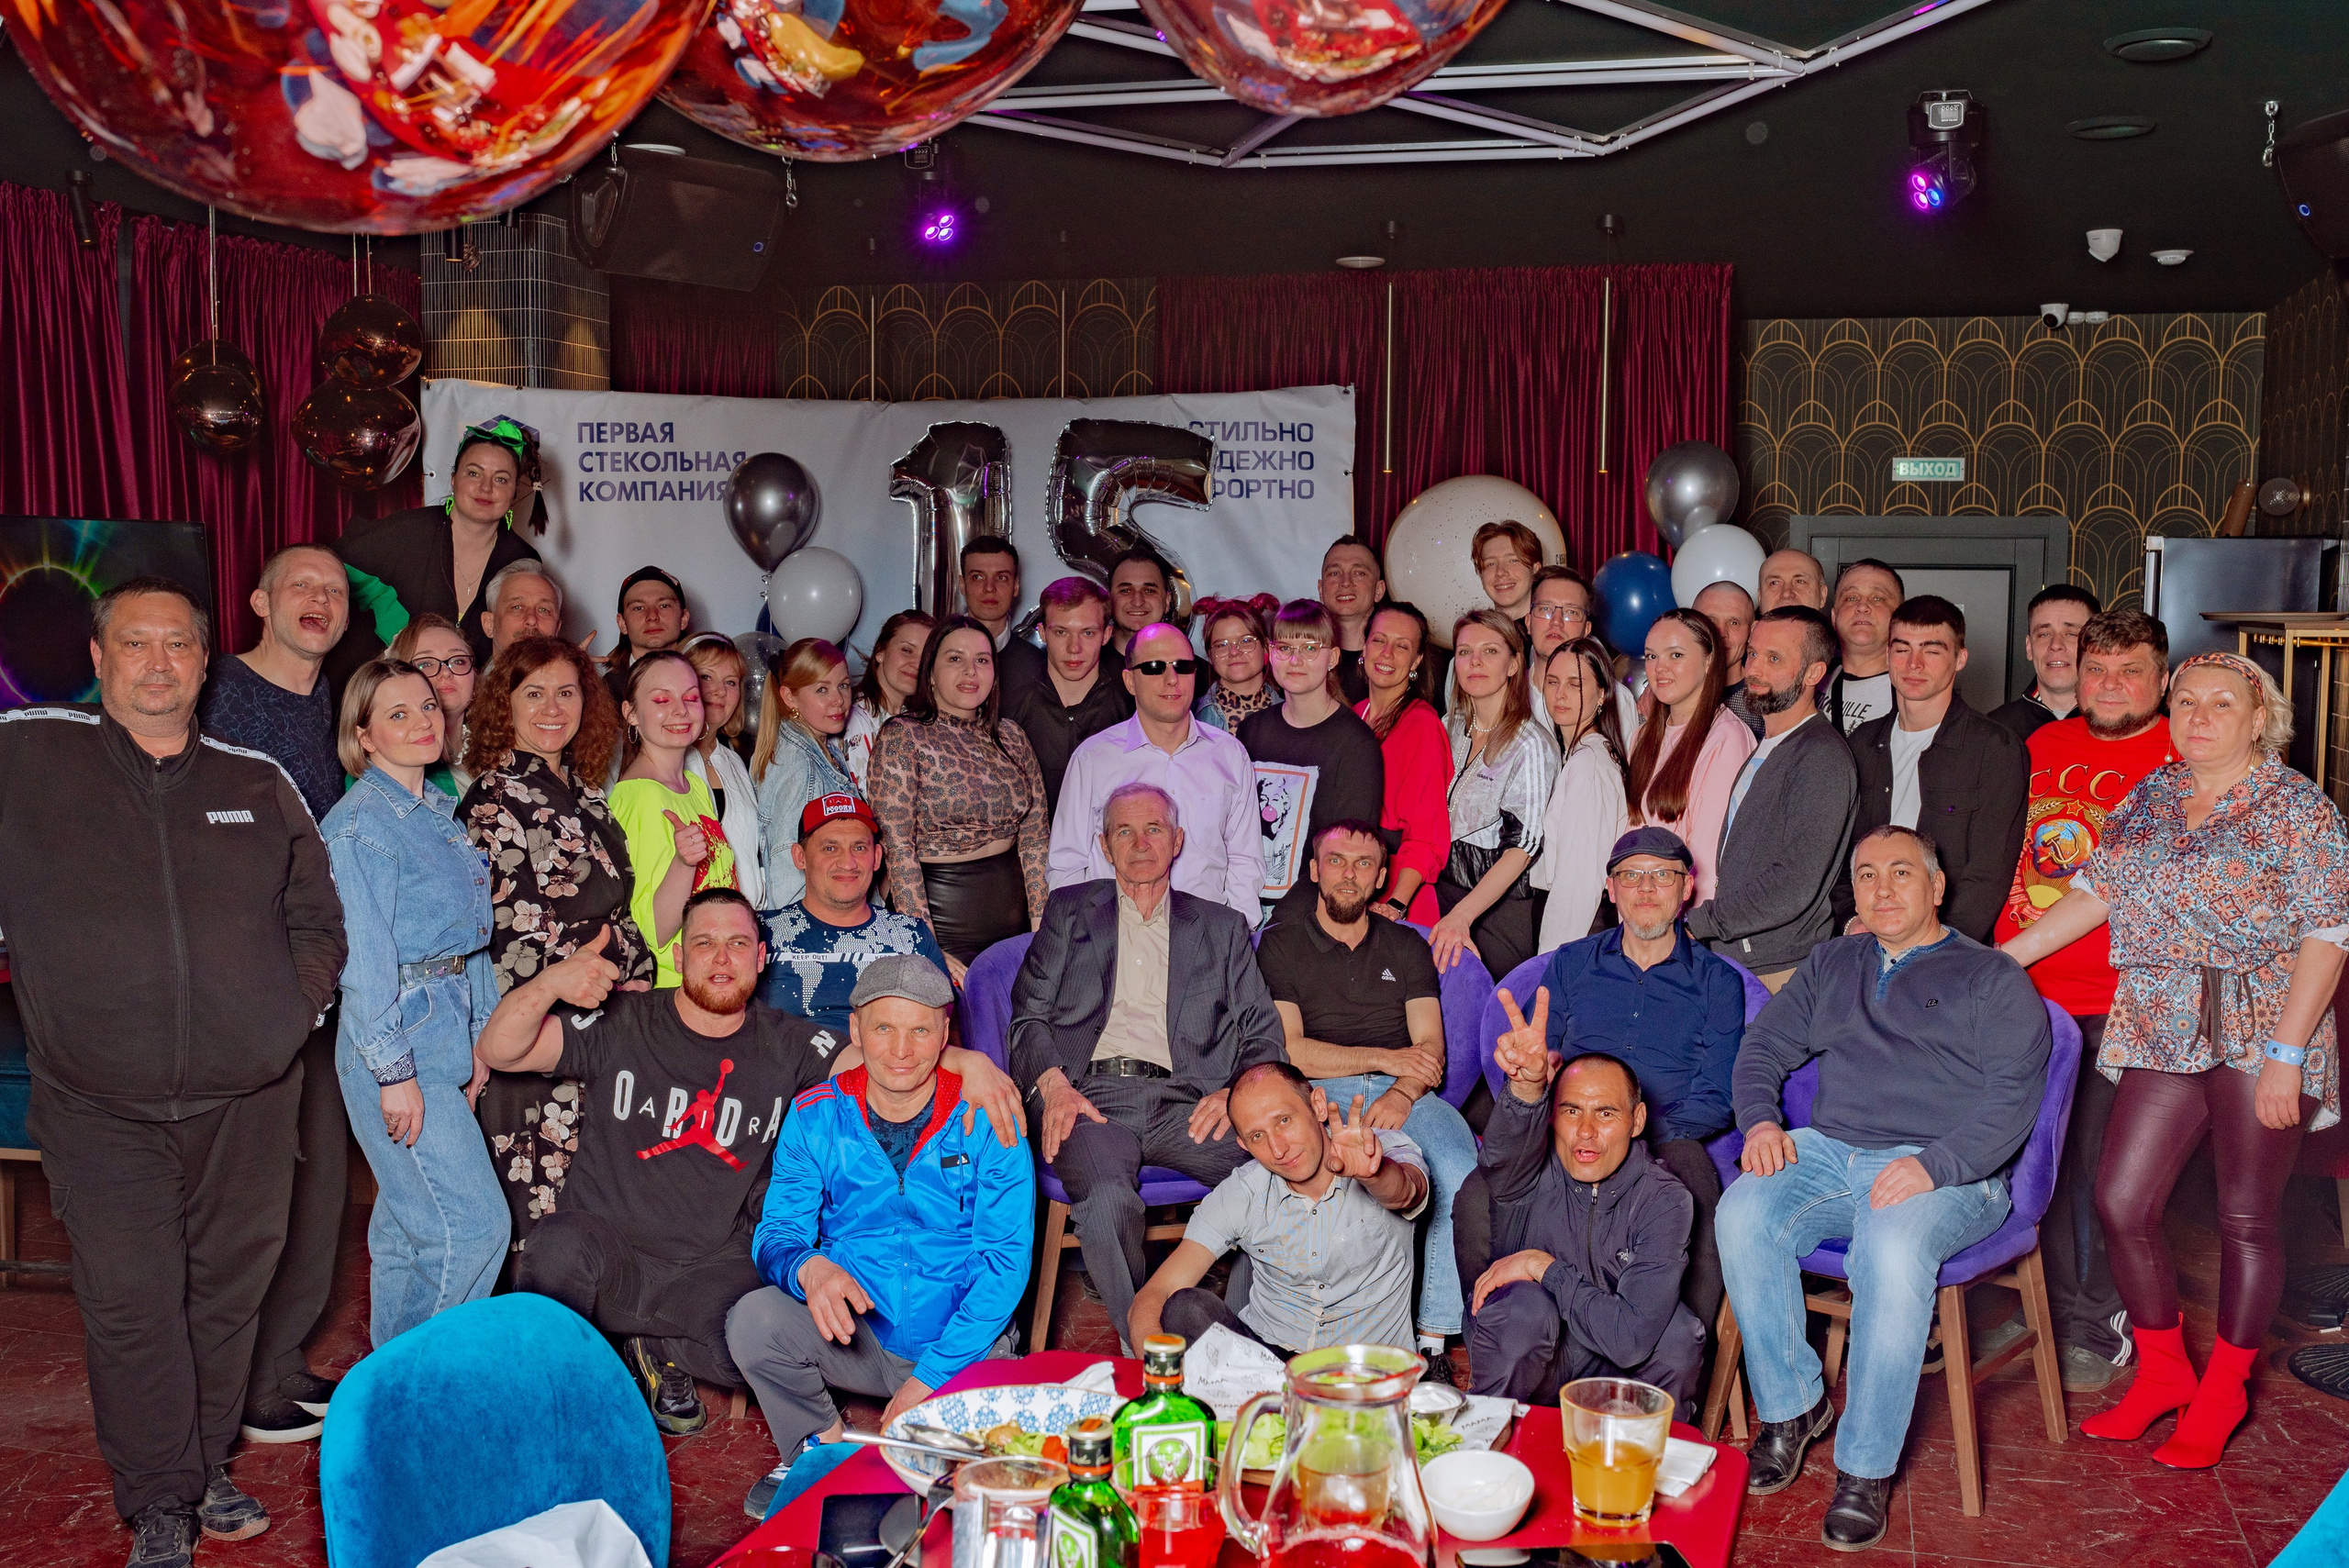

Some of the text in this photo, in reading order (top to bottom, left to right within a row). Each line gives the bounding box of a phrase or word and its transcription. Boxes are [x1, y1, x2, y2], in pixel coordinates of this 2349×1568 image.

[577, 421, 674, 444] ПЕРВАЯ
[578, 450, 747, 473] СТЕКОЛЬНАЯ
[1216, 450, 1315, 473] ДЕЖНО
[1898, 462, 1957, 477] ВЫХОД
[579, 480, 729, 503] КОМПАНИЯ
[2029, 763, 2128, 807] ССС
[206, 809, 254, 824] PUMA
